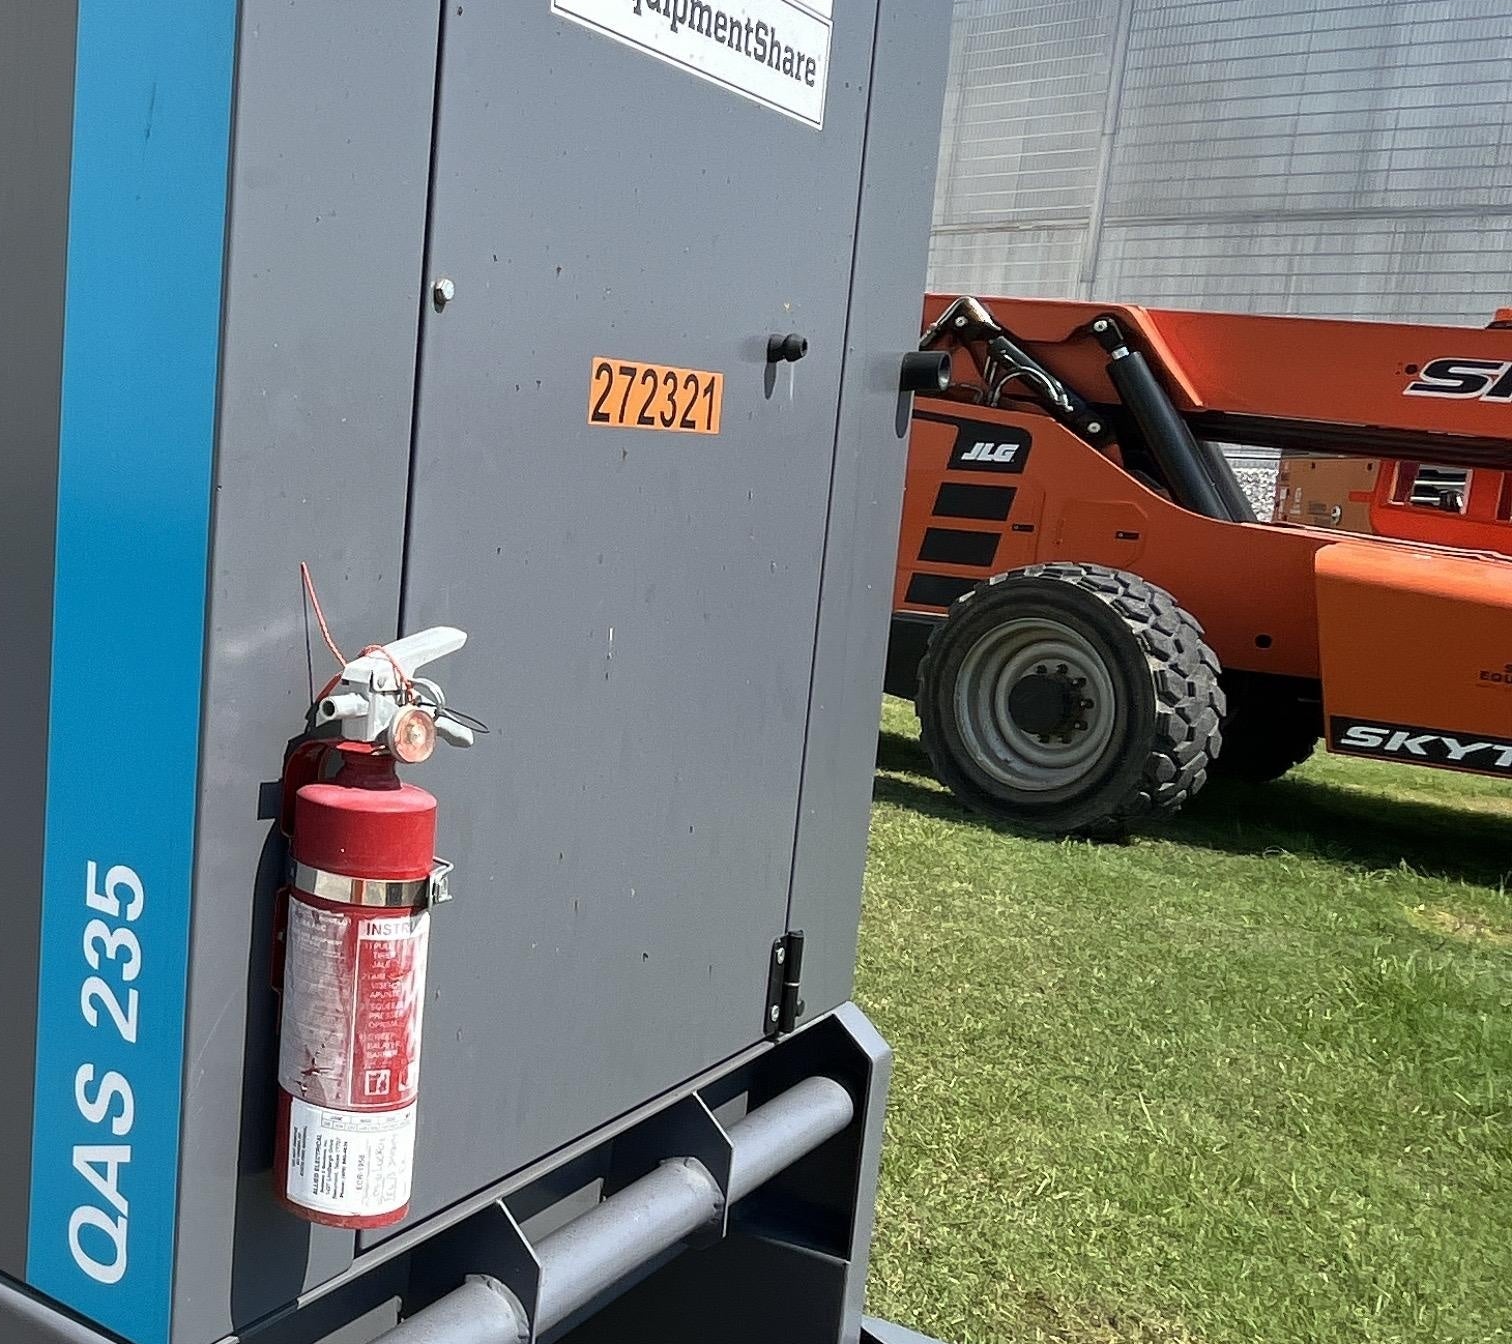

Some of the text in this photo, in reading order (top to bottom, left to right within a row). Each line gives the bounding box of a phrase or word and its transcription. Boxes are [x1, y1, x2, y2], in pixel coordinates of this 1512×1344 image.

[590, 361, 717, 432] 272321
[961, 442, 1020, 463] JLG
[68, 860, 145, 1285] QAS 235
